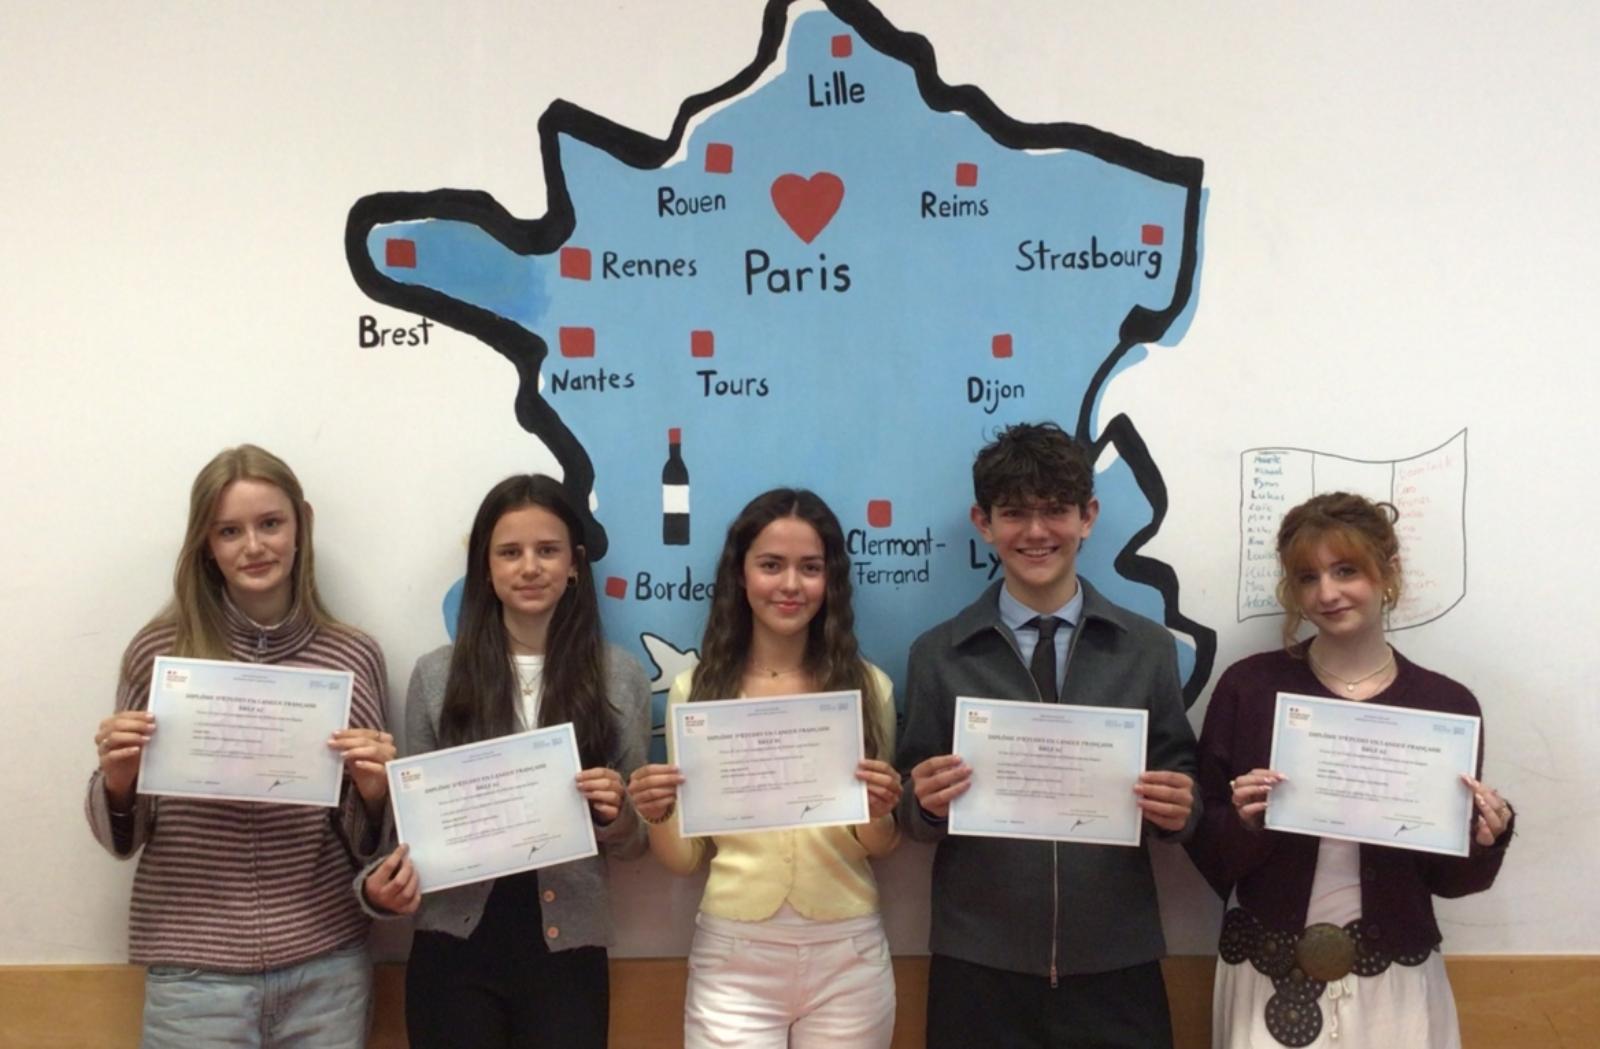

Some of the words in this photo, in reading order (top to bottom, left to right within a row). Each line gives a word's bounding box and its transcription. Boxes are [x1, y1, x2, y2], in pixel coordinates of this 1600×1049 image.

[809, 71, 865, 107] Lille
[658, 187, 726, 217] Rouen
[921, 191, 989, 219] Reims
[603, 251, 697, 279] Rennes
[745, 249, 851, 295] Paris
[1016, 235, 1162, 279] Strasbourg
[359, 315, 434, 349] Brest
[551, 368, 635, 394] Nantes
[696, 370, 769, 397] Tours
[967, 376, 1025, 414] Dijon
[847, 527, 946, 556] Clermont-
[854, 559, 930, 585] Ferrand
[969, 538, 1003, 581] Ly
[635, 565, 717, 602] Bordea
